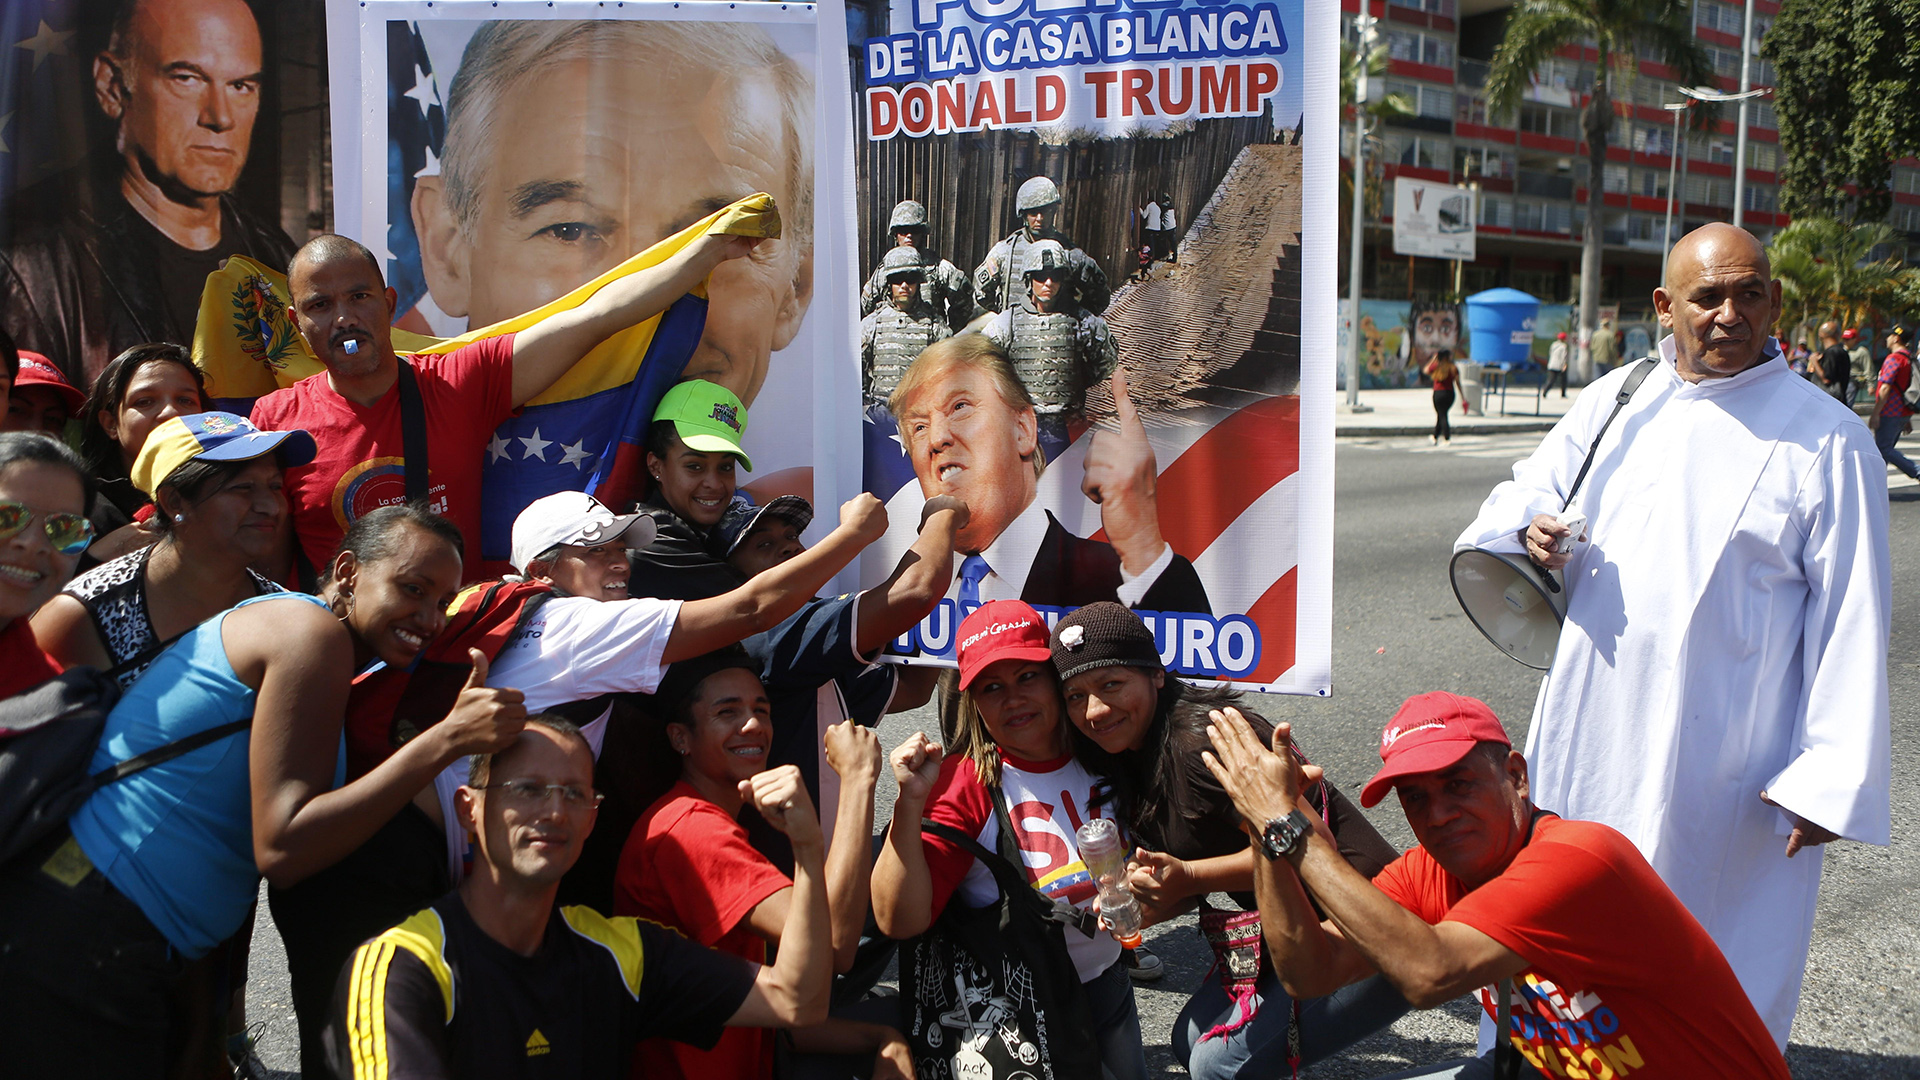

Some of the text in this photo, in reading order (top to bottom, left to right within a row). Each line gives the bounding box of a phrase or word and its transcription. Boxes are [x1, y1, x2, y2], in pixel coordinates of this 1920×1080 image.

[868, 38, 916, 80] DE
[927, 32, 975, 73] LA
[985, 21, 1094, 67] CASA
[1106, 9, 1282, 57] BLANCA
[869, 62, 1279, 137] DONALD TRUMP
[1143, 616, 1255, 672] URO
